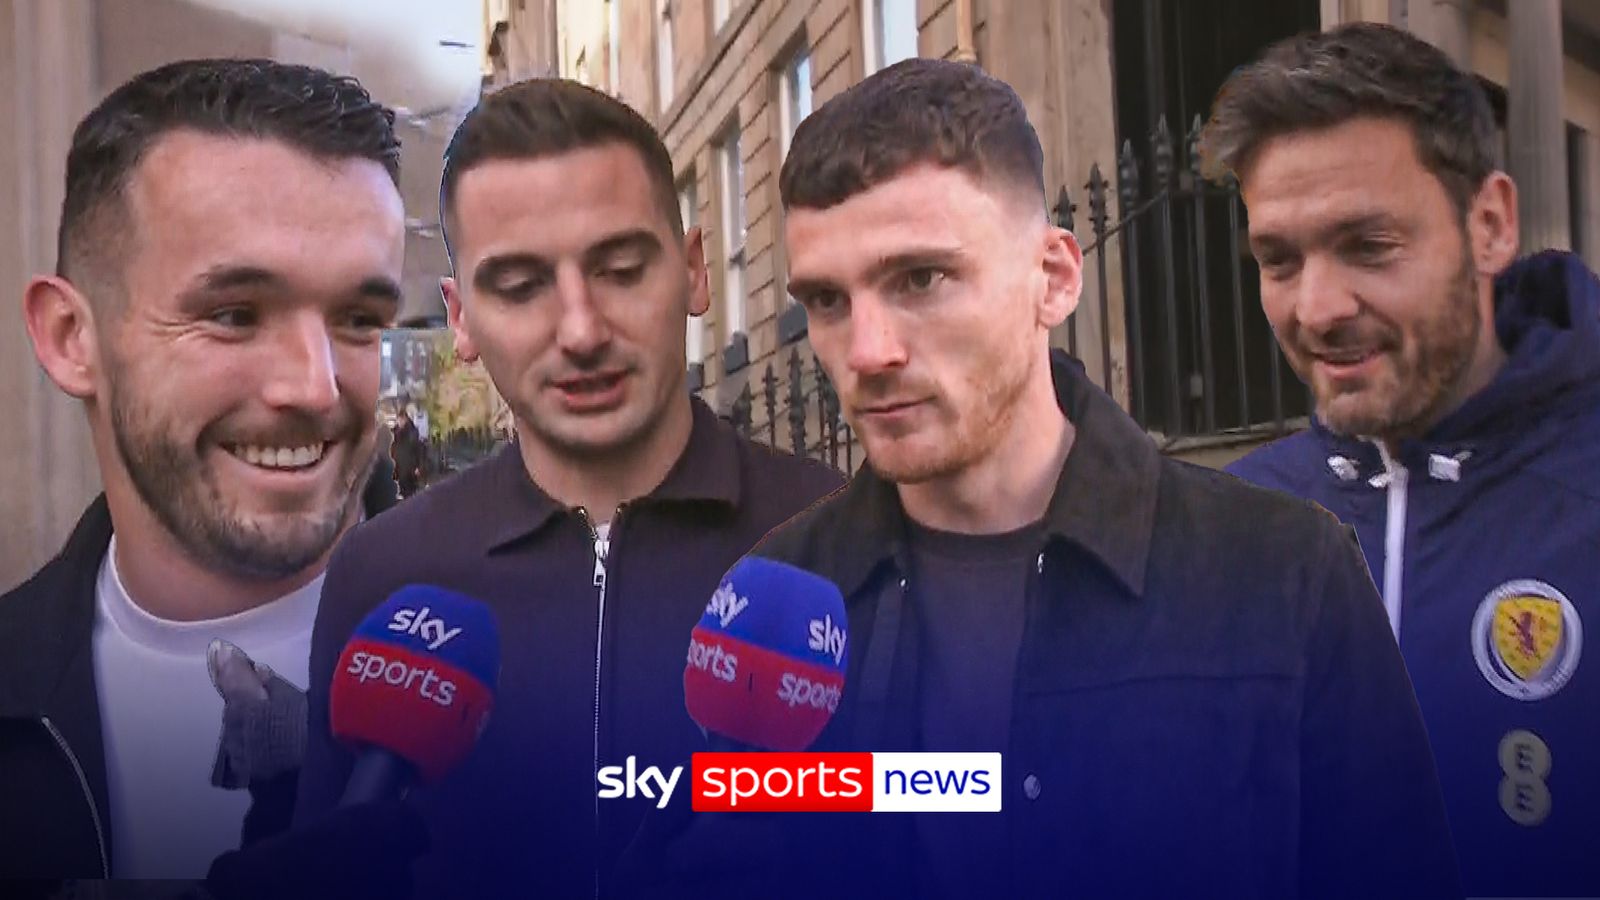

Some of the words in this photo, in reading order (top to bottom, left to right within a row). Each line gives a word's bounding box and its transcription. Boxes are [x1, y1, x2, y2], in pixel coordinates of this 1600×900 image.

[388, 607, 463, 650] sky
[808, 613, 847, 666] sky
[347, 652, 456, 706] sports
